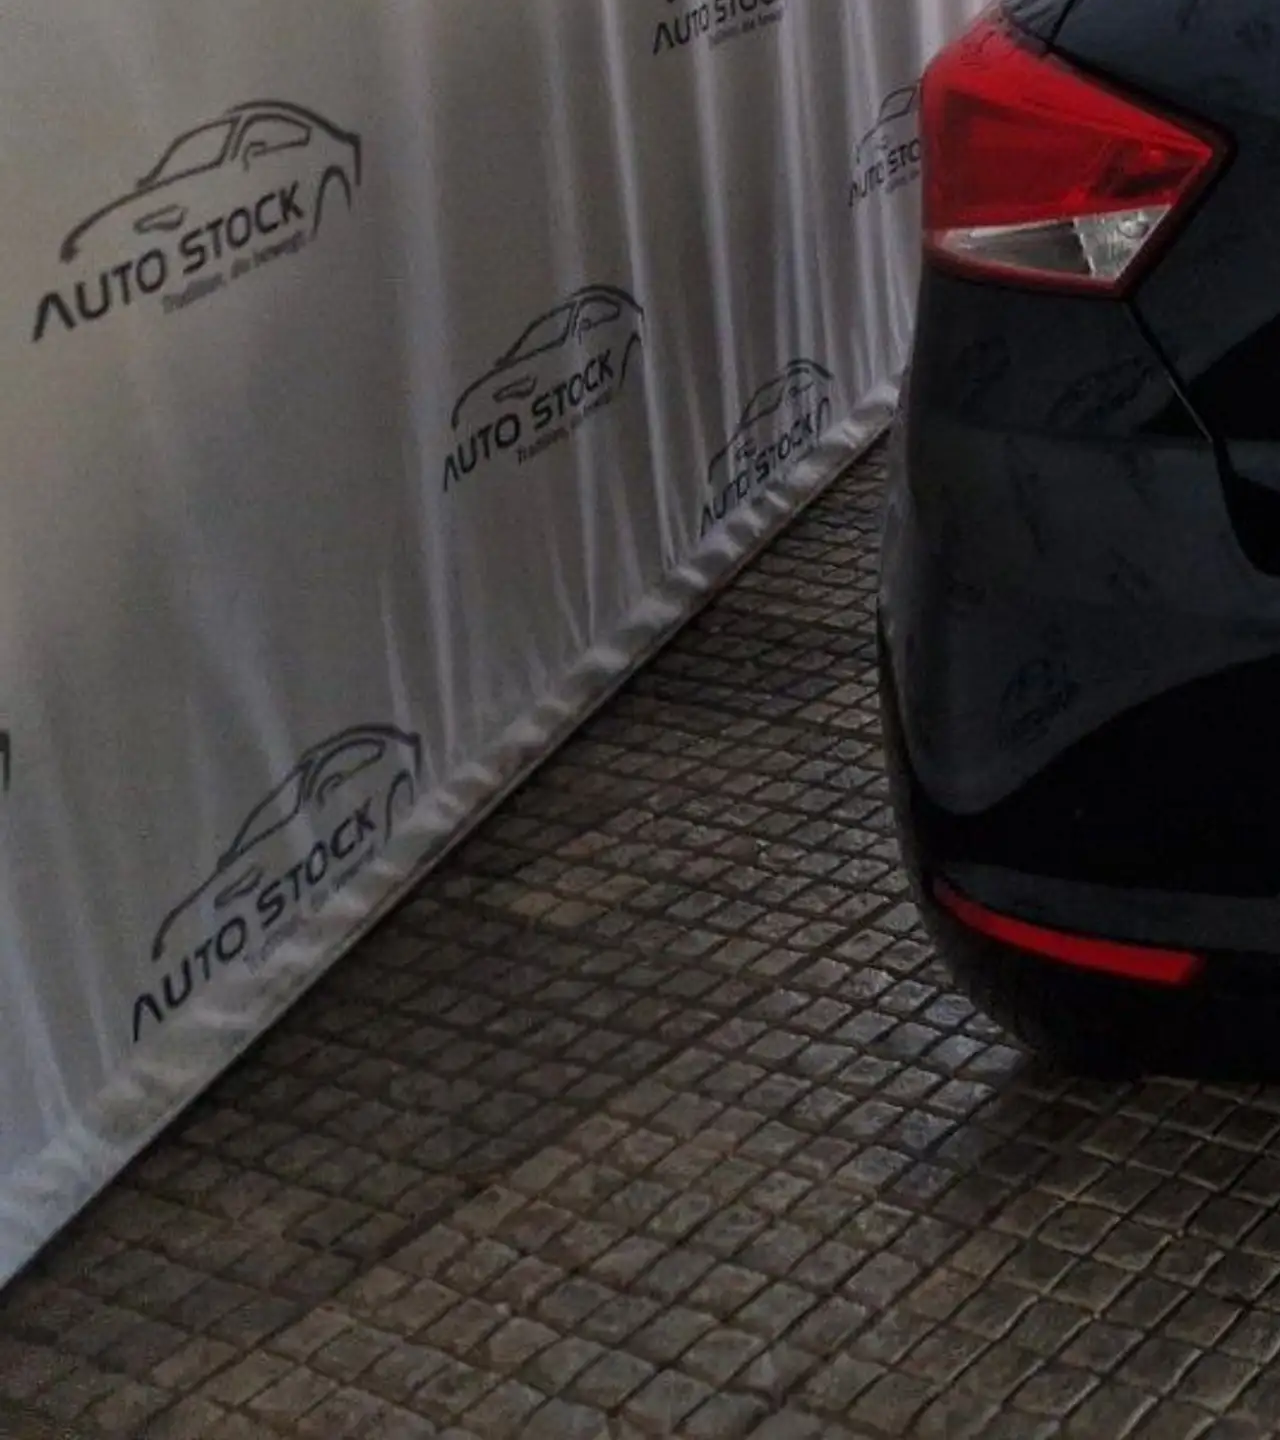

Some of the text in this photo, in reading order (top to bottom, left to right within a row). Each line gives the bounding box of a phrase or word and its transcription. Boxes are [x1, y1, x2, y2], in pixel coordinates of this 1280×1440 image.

[651, 3, 710, 56] AUTO
[886, 137, 921, 175] STO
[32, 182, 305, 344] AUTO STOCK
[442, 412, 521, 493] AUTO
[531, 348, 614, 433] STOCK
[131, 916, 248, 1045] AUTO
[256, 796, 377, 931] STOCK
